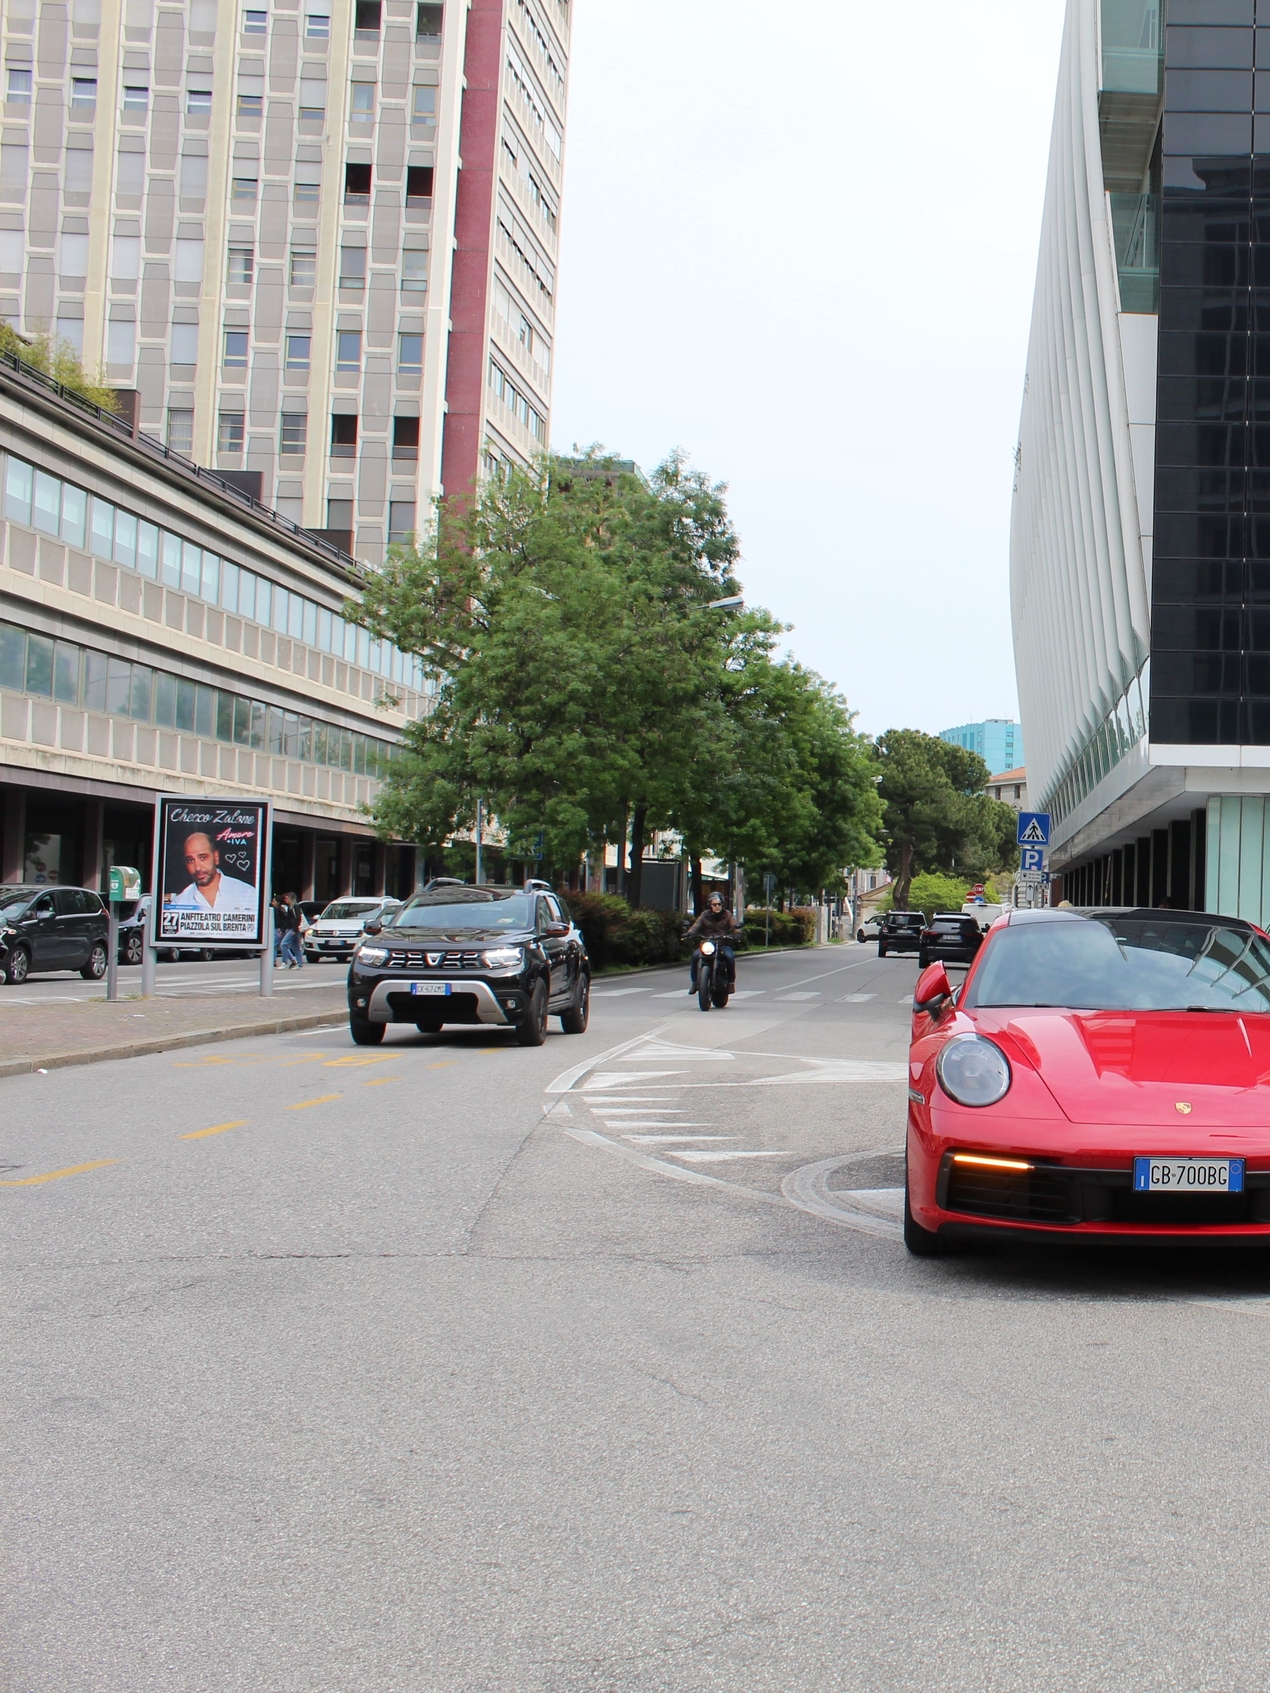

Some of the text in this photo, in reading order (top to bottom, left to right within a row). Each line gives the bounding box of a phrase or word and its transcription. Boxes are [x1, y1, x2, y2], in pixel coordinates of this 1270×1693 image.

[170, 808, 256, 824] Checco Zalone
[216, 827, 255, 841] Amore
[1025, 851, 1040, 868] P
[163, 913, 179, 926] 27
[180, 912, 255, 923] ANFITEATRO CAMERINI
[180, 922, 210, 931] PIAZZOLA
[210, 922, 222, 931] SUL
[223, 923, 246, 932] BRENTA
